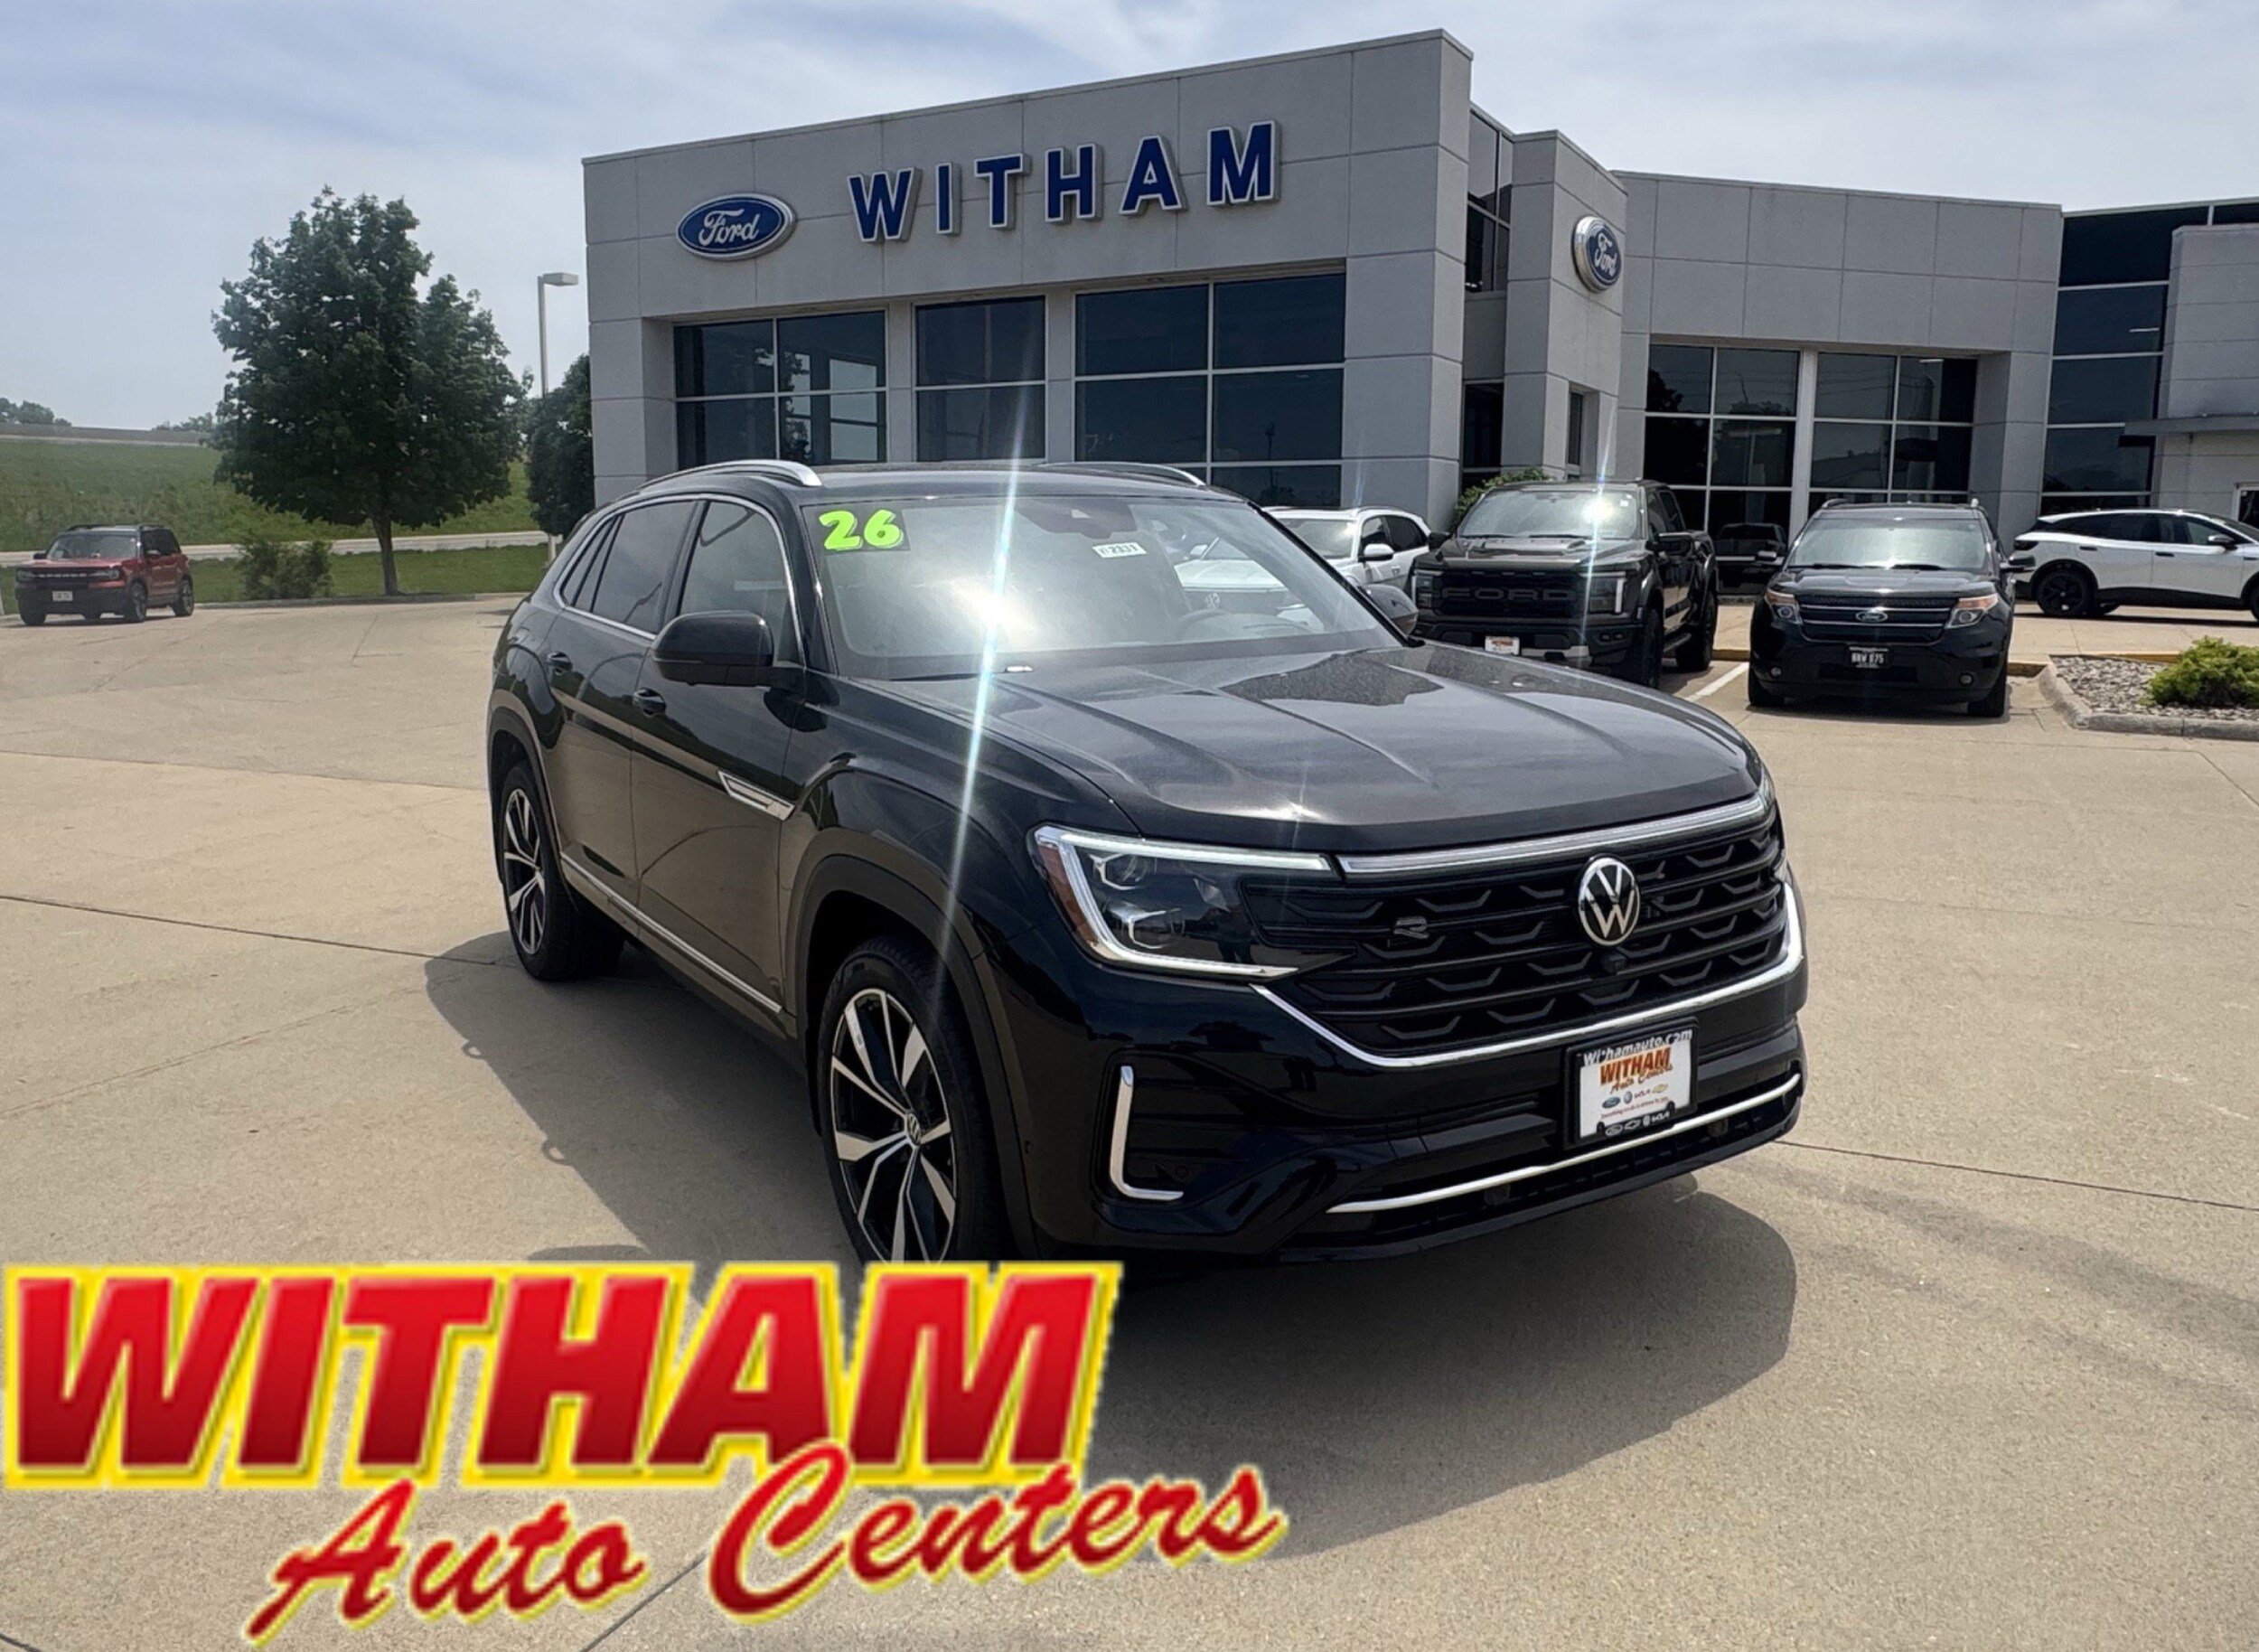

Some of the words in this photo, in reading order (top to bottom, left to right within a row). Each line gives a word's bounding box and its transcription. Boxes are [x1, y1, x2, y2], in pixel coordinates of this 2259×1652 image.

[848, 119, 1279, 243] WITHAM
[698, 209, 761, 247] Ford
[1594, 232, 1618, 277] Ford
[819, 509, 905, 551] 26
[1441, 587, 1575, 601] FORD
[1599, 1047, 1672, 1085] WITHAM
